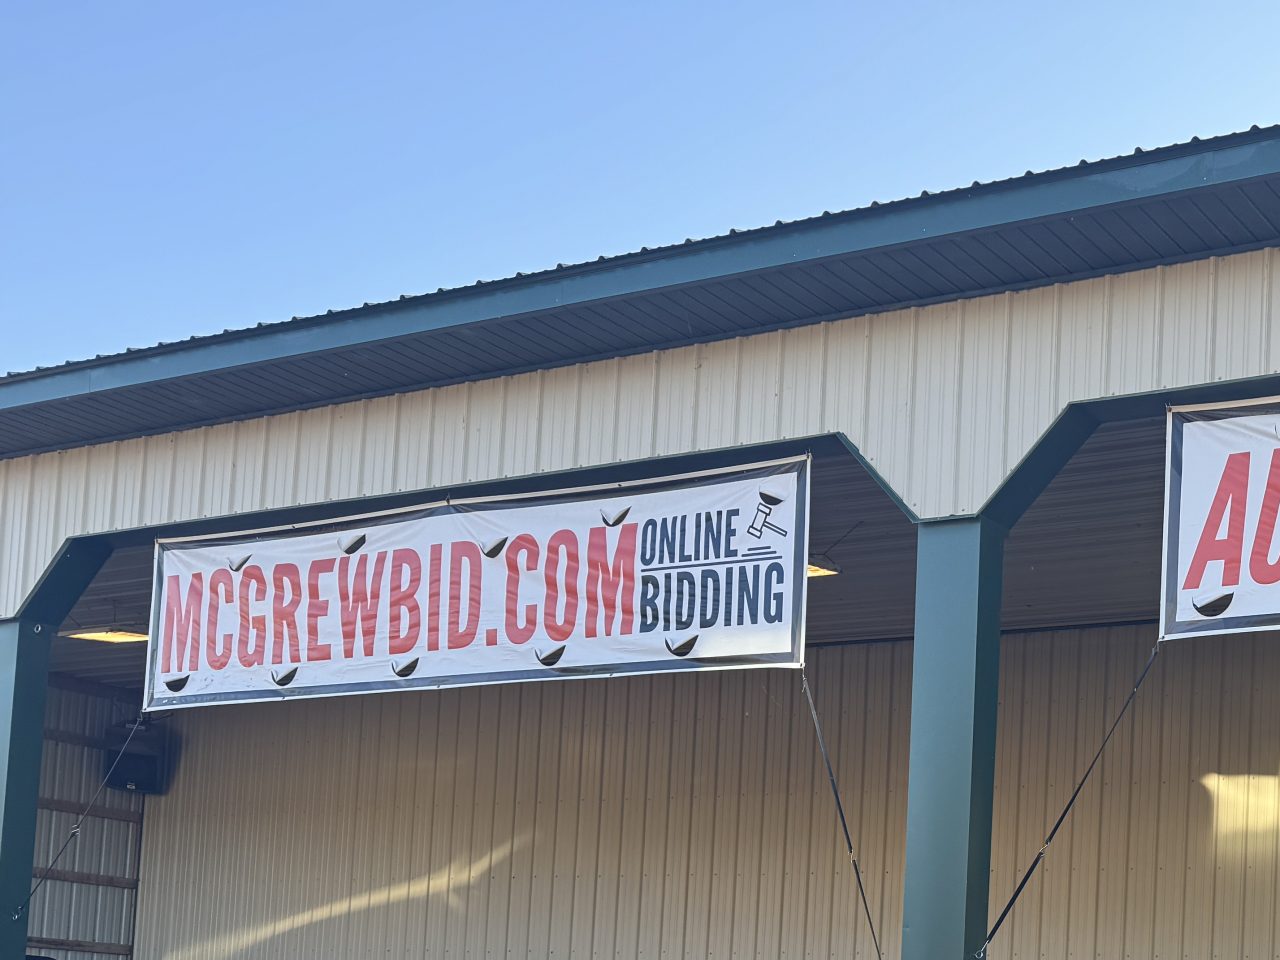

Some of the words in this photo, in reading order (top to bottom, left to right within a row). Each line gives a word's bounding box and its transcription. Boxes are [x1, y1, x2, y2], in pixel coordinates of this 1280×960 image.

[641, 507, 740, 567] ONLINE
[160, 521, 640, 675] MCGREWBID.COM
[639, 562, 785, 634] BIDDING
